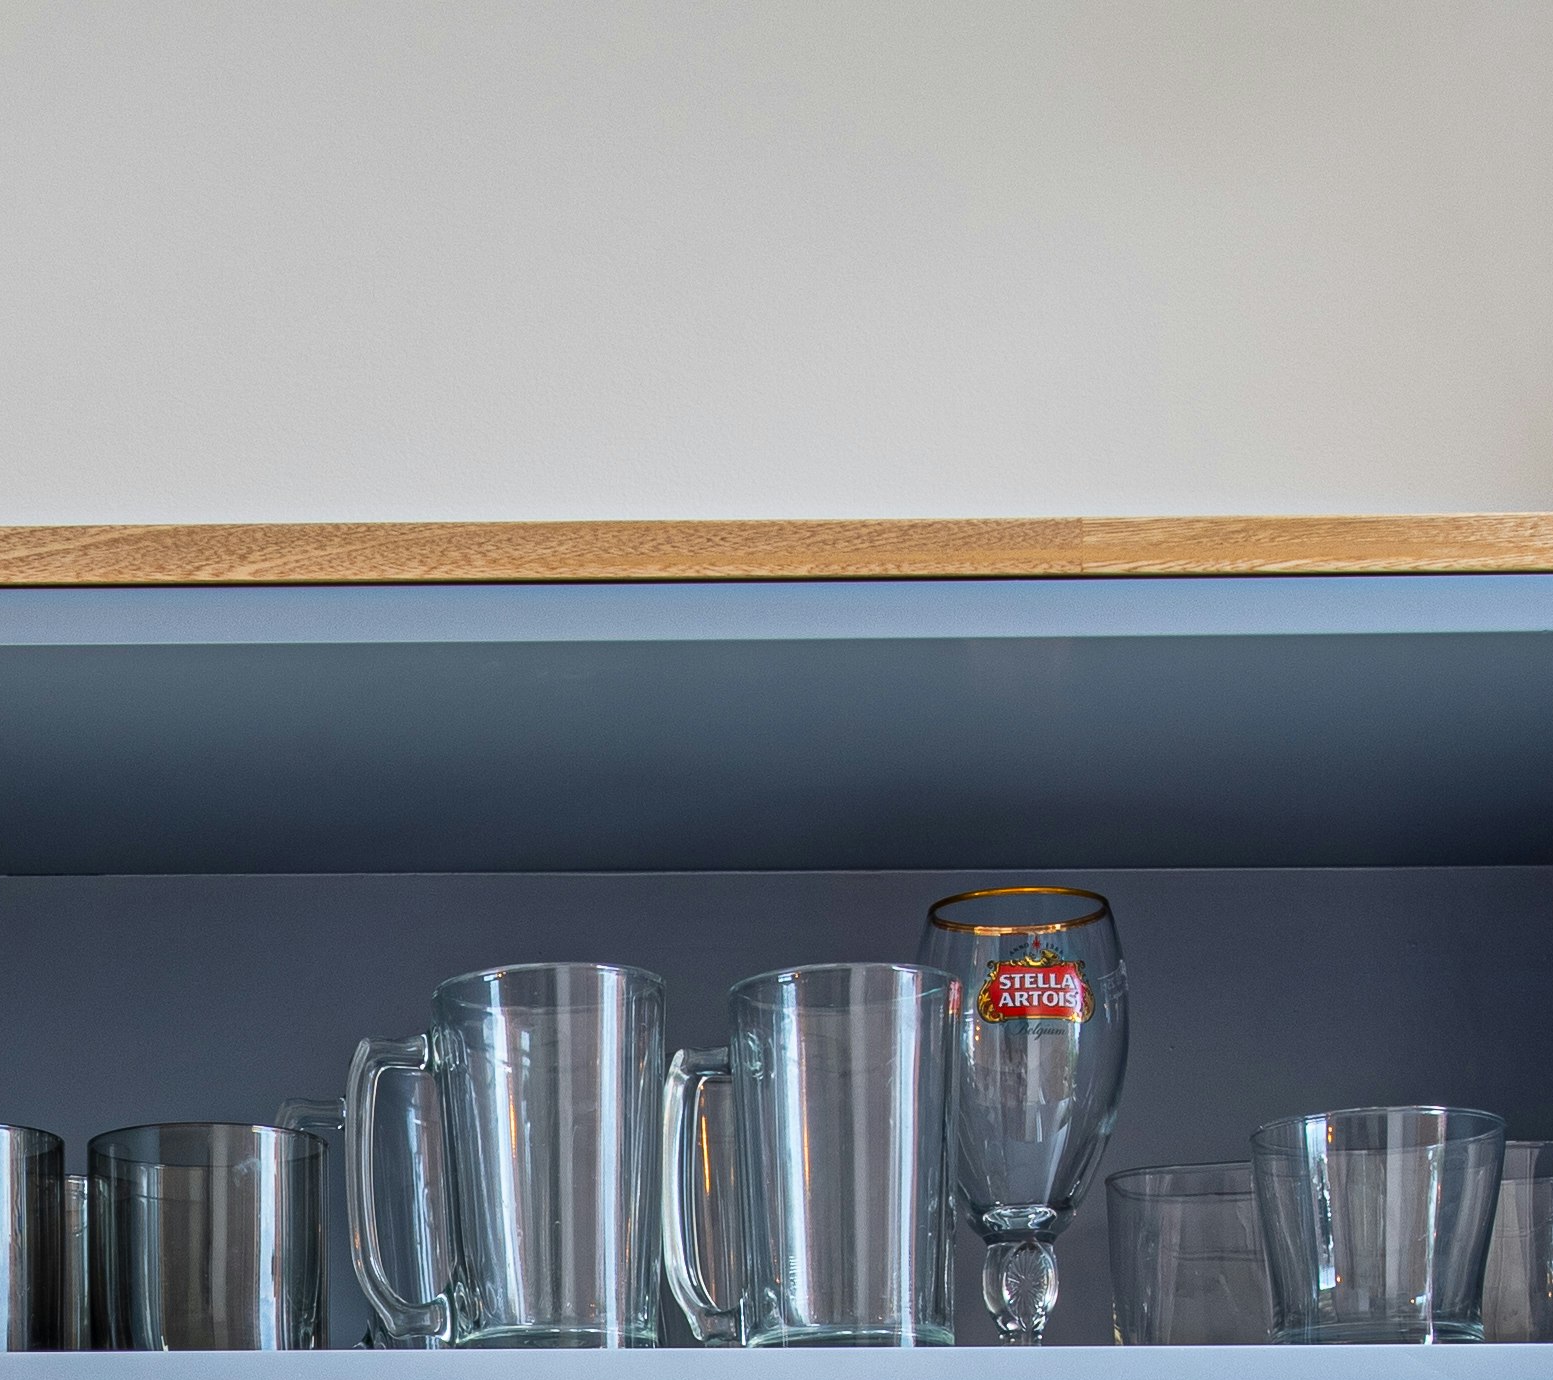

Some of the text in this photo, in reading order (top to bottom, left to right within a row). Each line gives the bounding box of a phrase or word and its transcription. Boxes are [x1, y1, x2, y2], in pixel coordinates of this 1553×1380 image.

[999, 973, 1076, 989] STELLA
[998, 991, 1078, 1007] ARTOIS
[1010, 1023, 1067, 1040] Belgium
